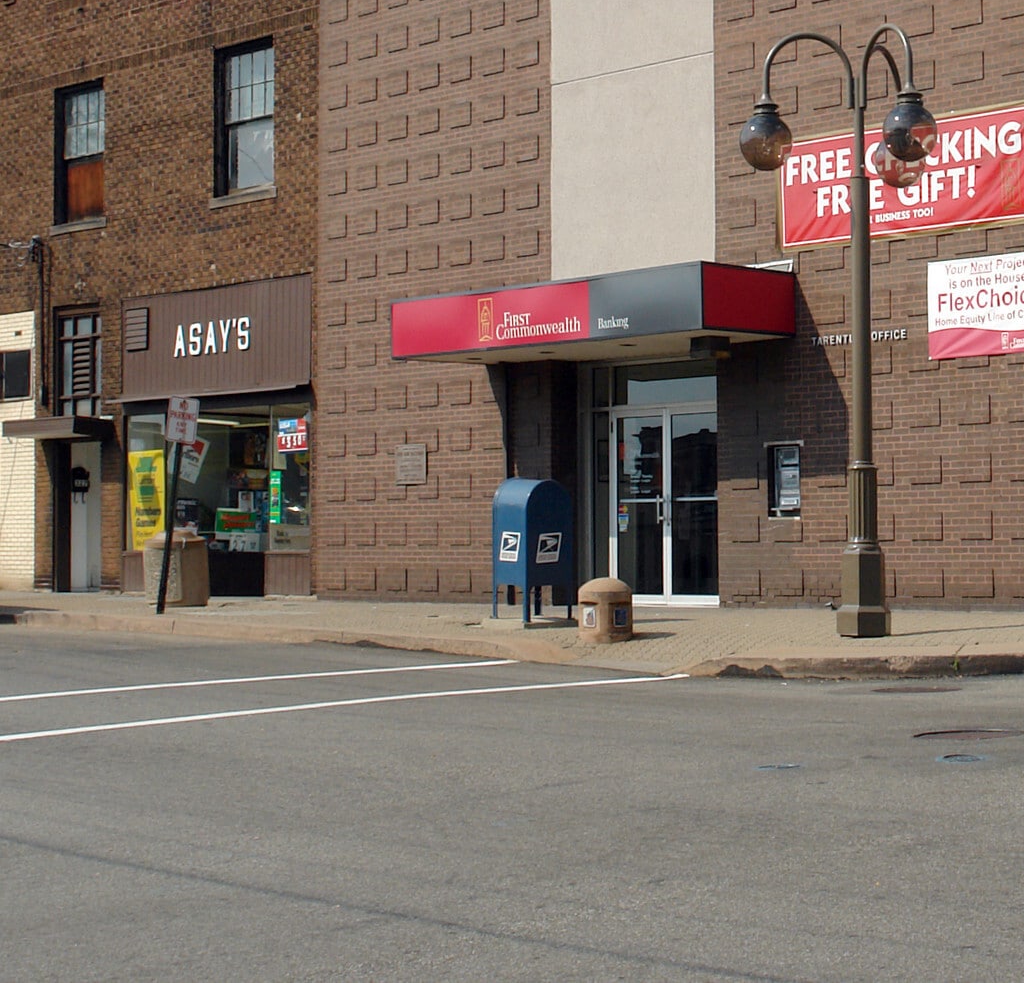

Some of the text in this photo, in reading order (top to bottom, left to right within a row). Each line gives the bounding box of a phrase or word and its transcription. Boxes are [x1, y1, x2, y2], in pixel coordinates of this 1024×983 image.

[786, 147, 852, 186] FREE
[817, 165, 977, 217] FRE GIFT!
[875, 209, 910, 223] BUSINESS
[912, 206, 934, 218] TOO!
[945, 264, 967, 276] Your
[970, 261, 993, 274] Next
[949, 279, 957, 289] is
[960, 279, 973, 288] on
[976, 276, 991, 287] the
[935, 317, 958, 327] Home
[960, 314, 986, 325] Equity
[988, 311, 1004, 322] Line
[1007, 310, 1016, 320] of
[174, 316, 250, 358] ASAY'S
[496, 316, 629, 340] Commonwealth Banking
[811, 329, 907, 347] TARENT OFFICE
